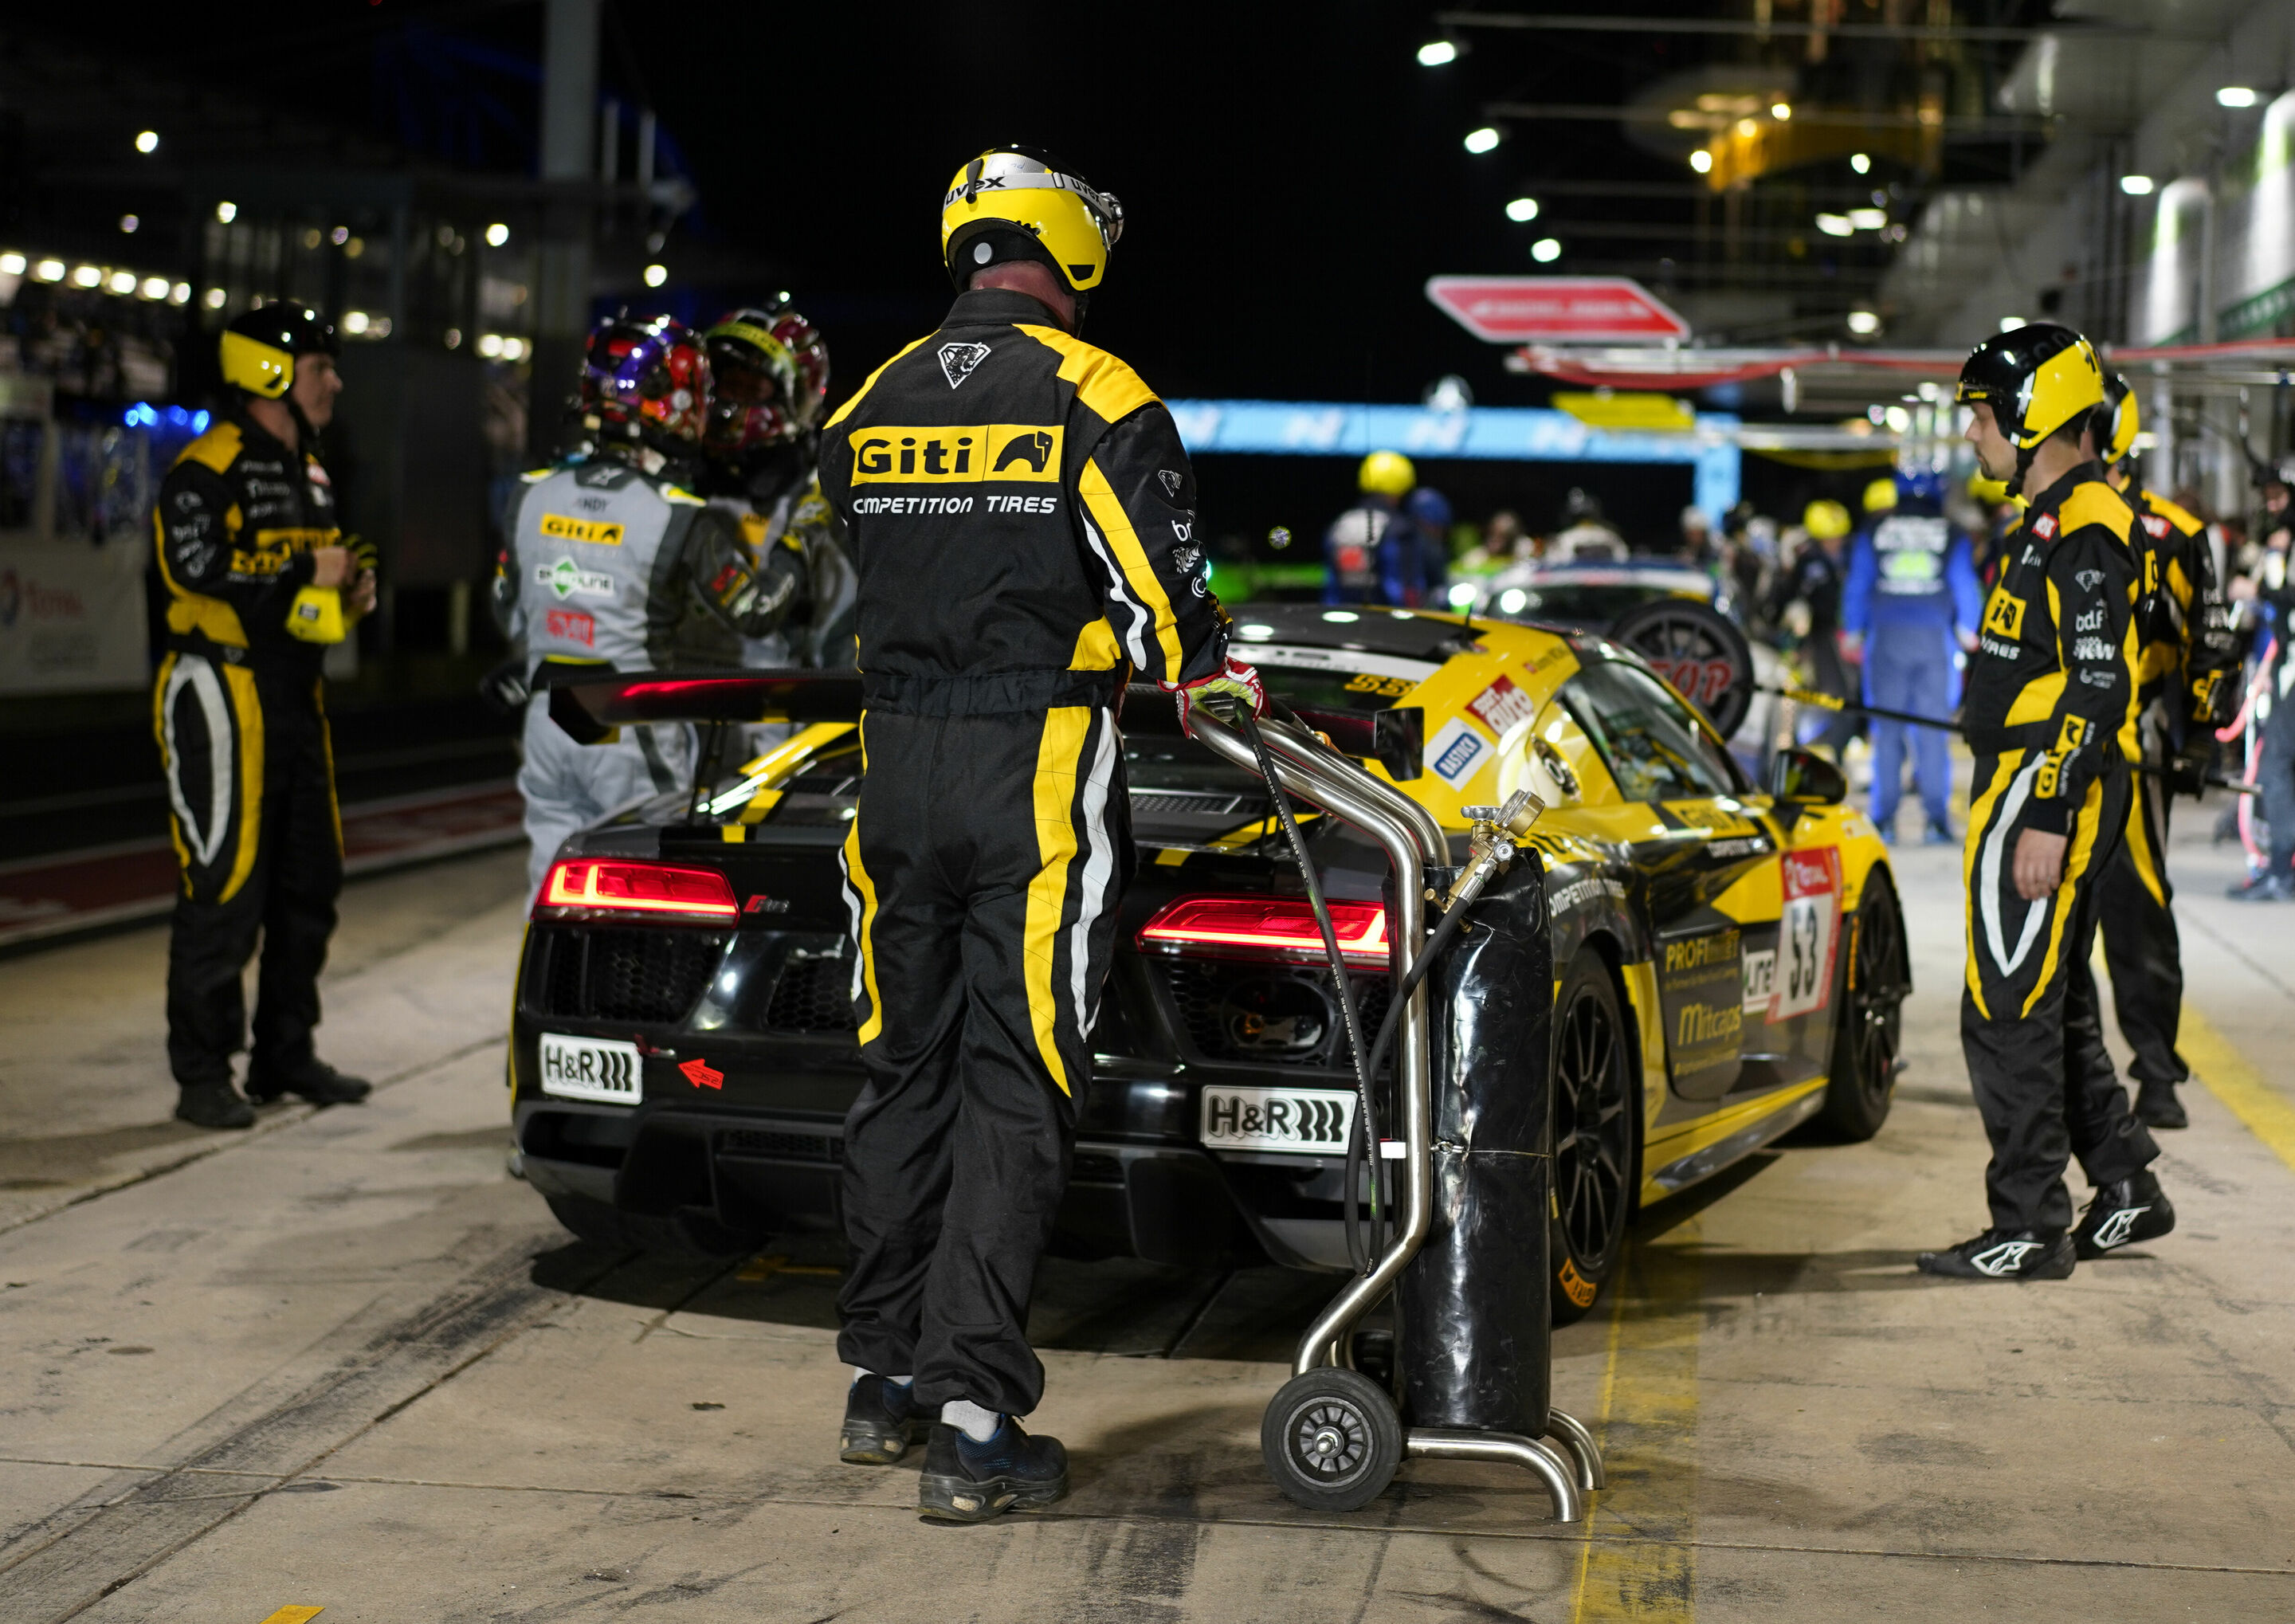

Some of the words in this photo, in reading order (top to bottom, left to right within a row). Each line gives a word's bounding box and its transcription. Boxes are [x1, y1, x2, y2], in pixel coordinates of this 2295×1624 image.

[945, 176, 1006, 206] uvex
[1070, 178, 1103, 206] uvex
[857, 437, 973, 475] Giti
[852, 496, 974, 515] CMPETITION
[987, 496, 1058, 514] TIRES
[1344, 673, 1417, 696] 53
[1438, 735, 1478, 776] BASTUCK
[1789, 904, 1818, 1001] 53
[545, 1044, 598, 1082] H&R
[1208, 1096, 1293, 1136] H&R
